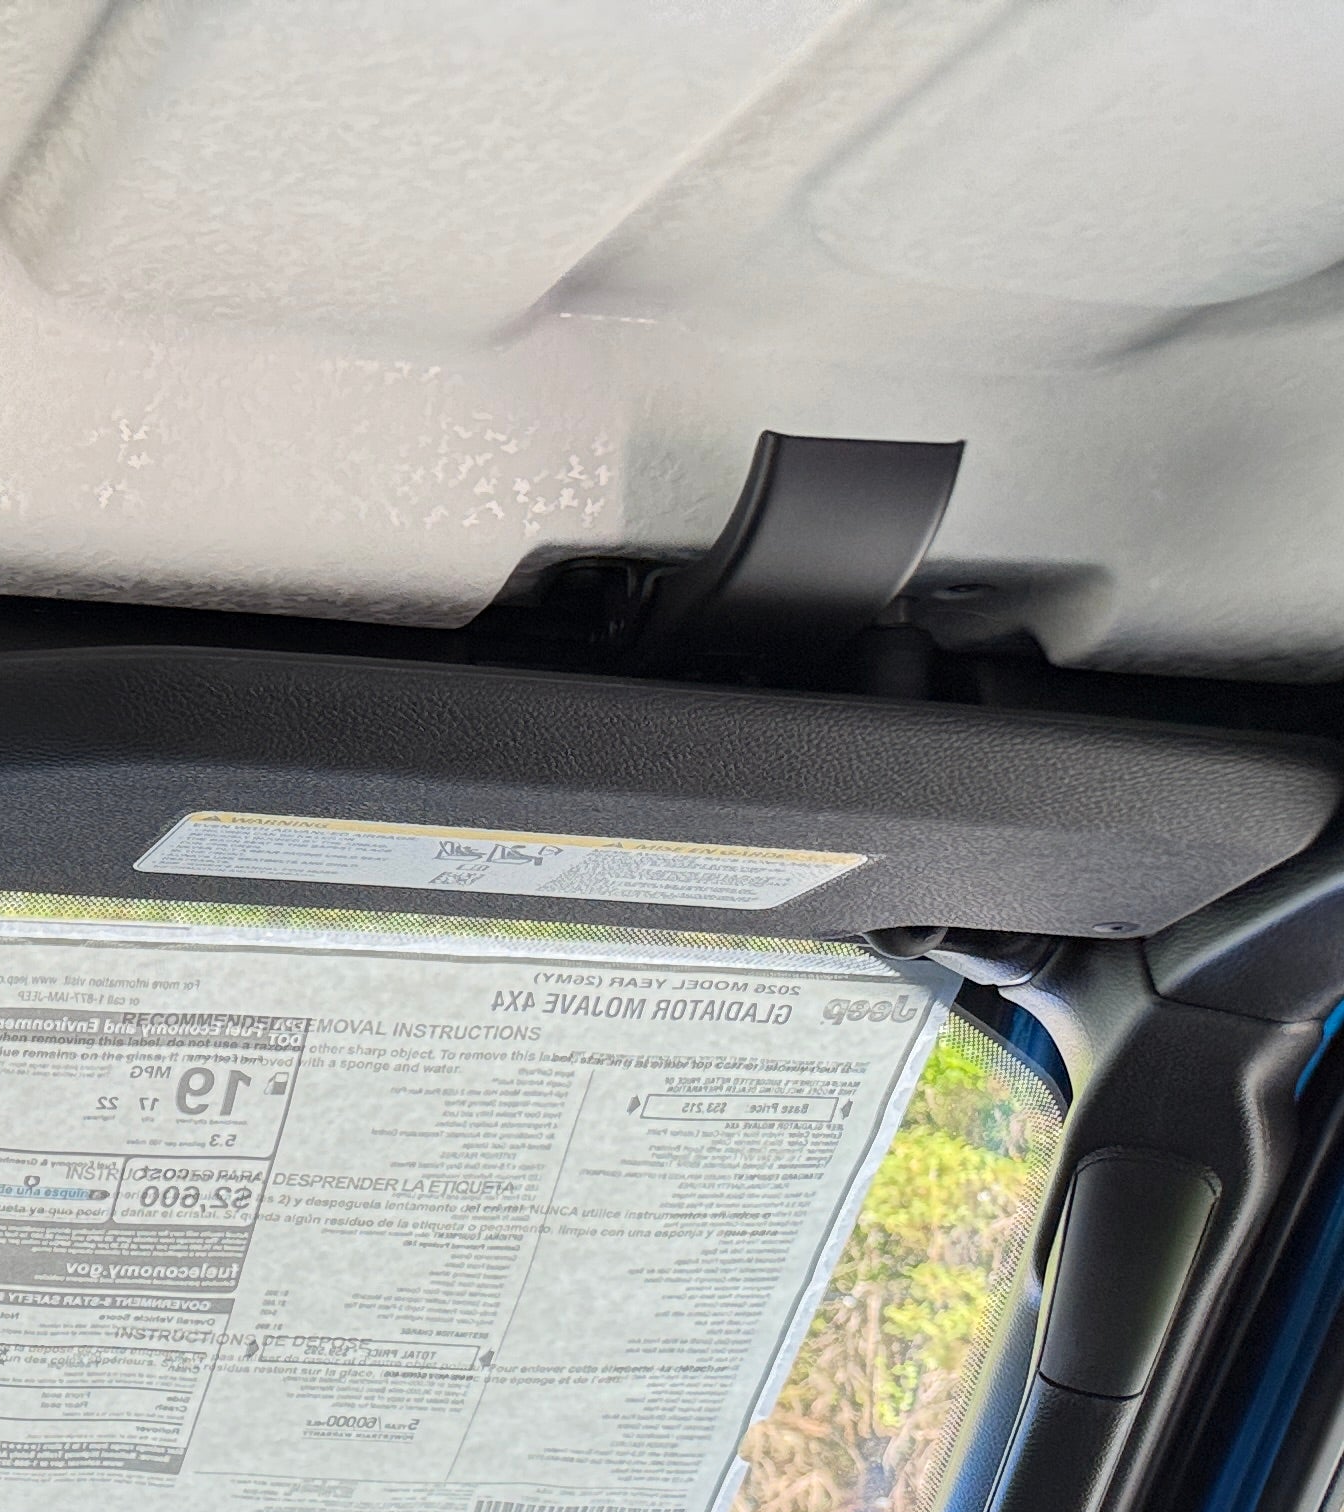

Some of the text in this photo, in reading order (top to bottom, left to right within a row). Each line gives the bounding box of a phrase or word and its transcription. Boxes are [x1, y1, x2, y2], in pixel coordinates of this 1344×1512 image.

[393, 1021, 543, 1042] INSTRUCTIONS
[309, 1043, 346, 1056] other
[348, 1045, 386, 1060] sharp
[440, 1050, 456, 1061] To
[459, 1051, 507, 1062] remove
[511, 1050, 536, 1062] this
[350, 1060, 390, 1073] sponge
[393, 1061, 419, 1074] and
[272, 1172, 516, 1197] DESPRENDER LA ETIQUETA
